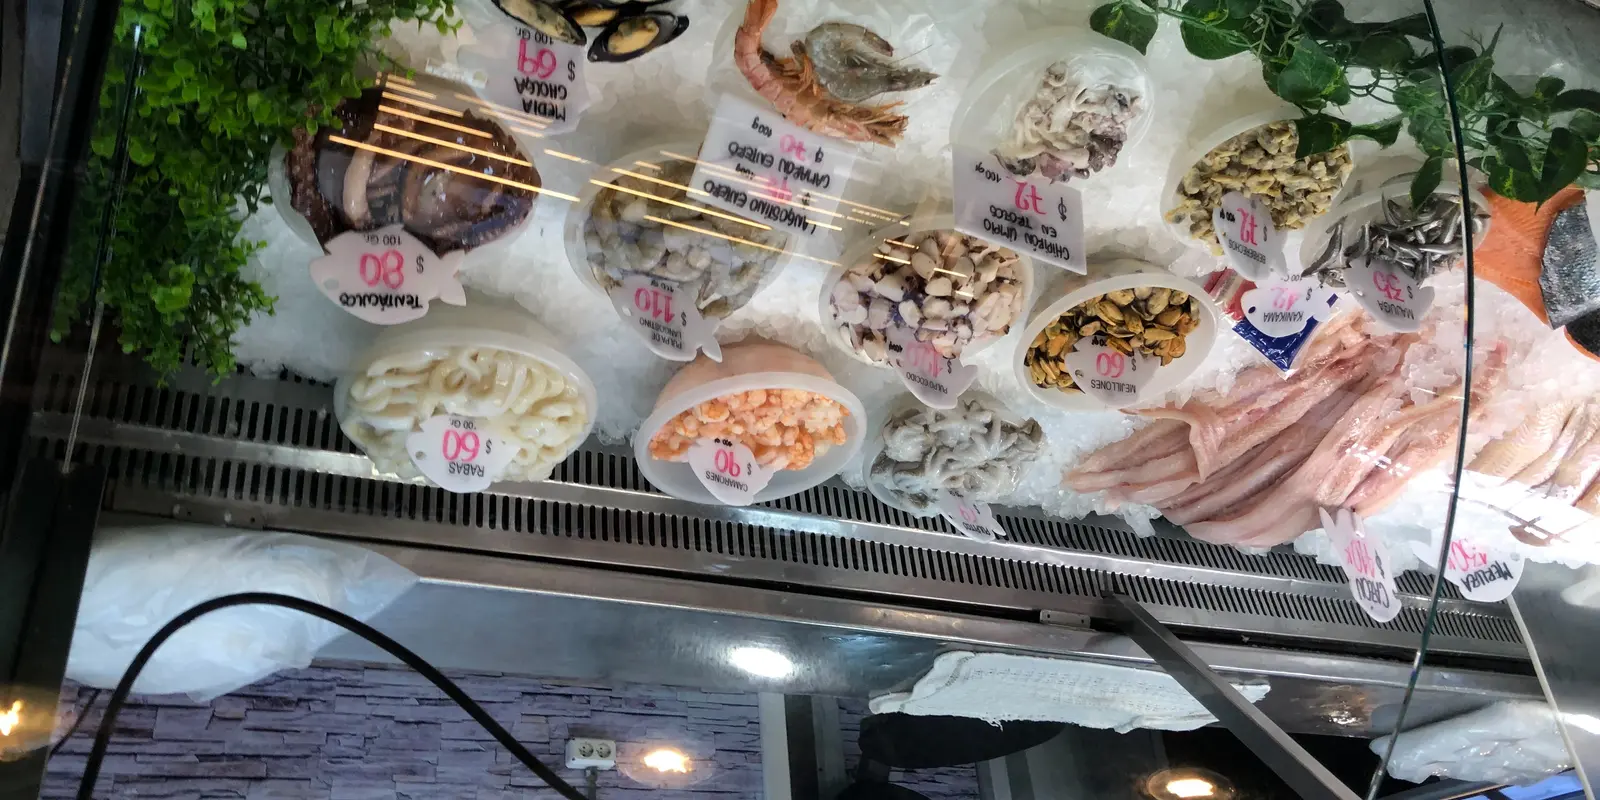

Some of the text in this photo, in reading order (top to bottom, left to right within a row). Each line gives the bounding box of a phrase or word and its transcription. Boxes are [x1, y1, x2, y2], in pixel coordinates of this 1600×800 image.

[517, 37, 576, 82] $ 69
[751, 117, 772, 138] 100g
[728, 141, 830, 189] CAMARÓN ENTERO
[985, 169, 1002, 183] 100
[703, 180, 747, 208] ENTERO
[1010, 179, 1067, 222] $ 72
[989, 205, 1057, 238] EN TROZOS
[1236, 208, 1258, 246] 72
[363, 234, 402, 246] 100 Gr.
[983, 218, 1070, 261] CHIPIRÓN LIMPIO
[1228, 239, 1266, 265] BERBERECHOS
[359, 249, 424, 289] $ 80
[1306, 288, 1312, 301] $
[1407, 286, 1413, 299] $
[634, 288, 687, 327] $ 110
[1263, 311, 1304, 322] KANIKAMA
[1377, 300, 1414, 320] MAJUGA
[639, 317, 682, 338] LANGOSTINO
[660, 335, 682, 349] PULPA
[947, 359, 952, 374] $
[1096, 352, 1136, 378] $ 60
[906, 371, 948, 394] PULPO COCIDO
[1090, 379, 1136, 393] MEJILLONES
[442, 430, 492, 462] $ 60
[448, 462, 484, 477] RABAS
[714, 449, 752, 477] $ 90
[705, 471, 748, 492] CAMARONES
[1375, 549, 1385, 579] $
[1460, 560, 1514, 592] MERLUZA
